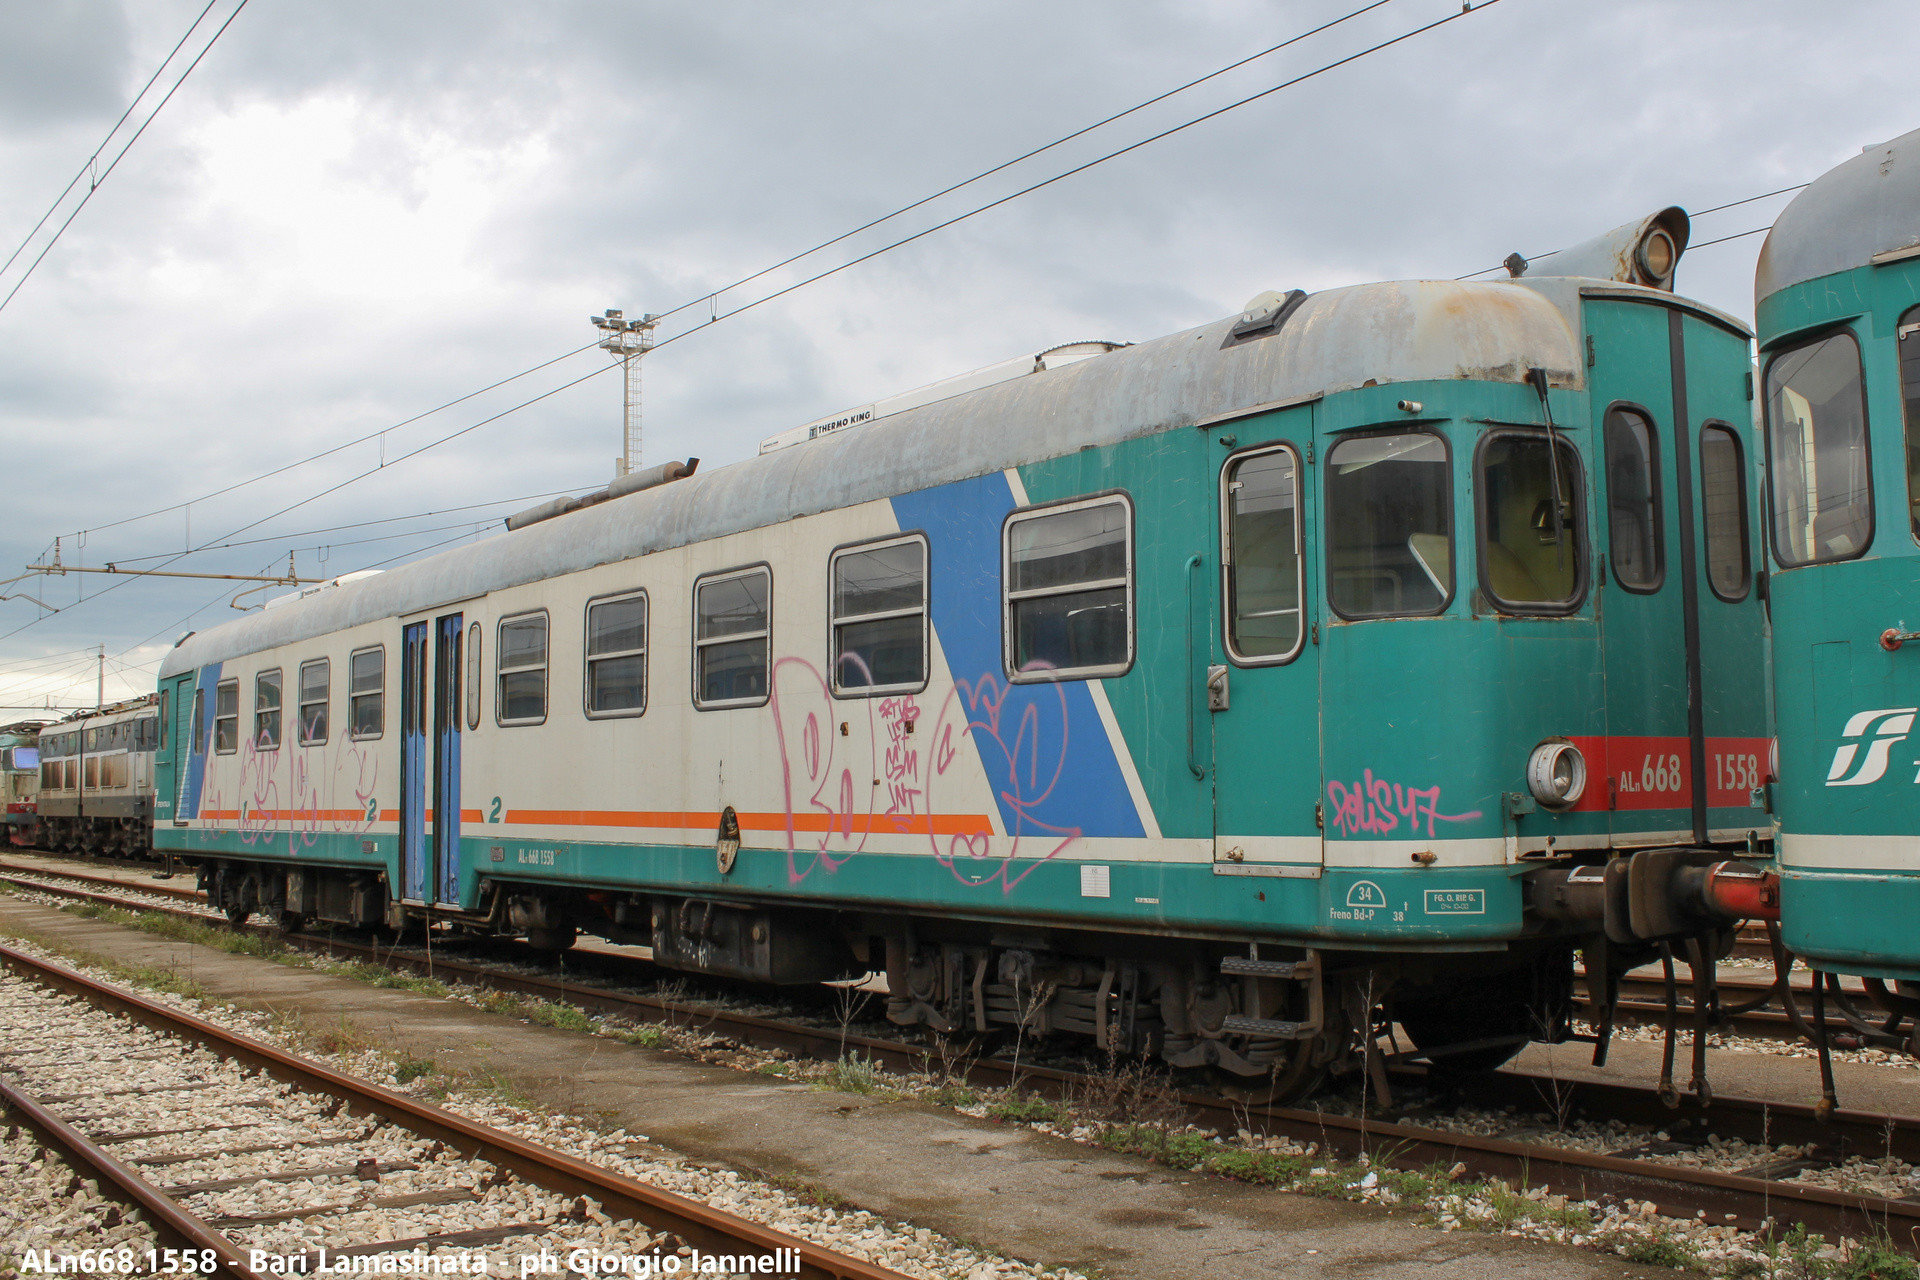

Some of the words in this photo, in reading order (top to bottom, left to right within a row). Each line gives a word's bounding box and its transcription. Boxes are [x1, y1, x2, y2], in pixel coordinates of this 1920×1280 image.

[818, 418, 849, 434] THERMO
[850, 411, 871, 424] KING
[1715, 754, 1759, 790] 1558
[367, 798, 377, 821] 2
[488, 796, 502, 823] 2
[540, 849, 555, 866] 1558
[1358, 887, 1372, 901] 34
[1329, 907, 1351, 920] Freno
[1353, 908, 1375, 921] Bd-P
[1392, 911, 1405, 922] 38
